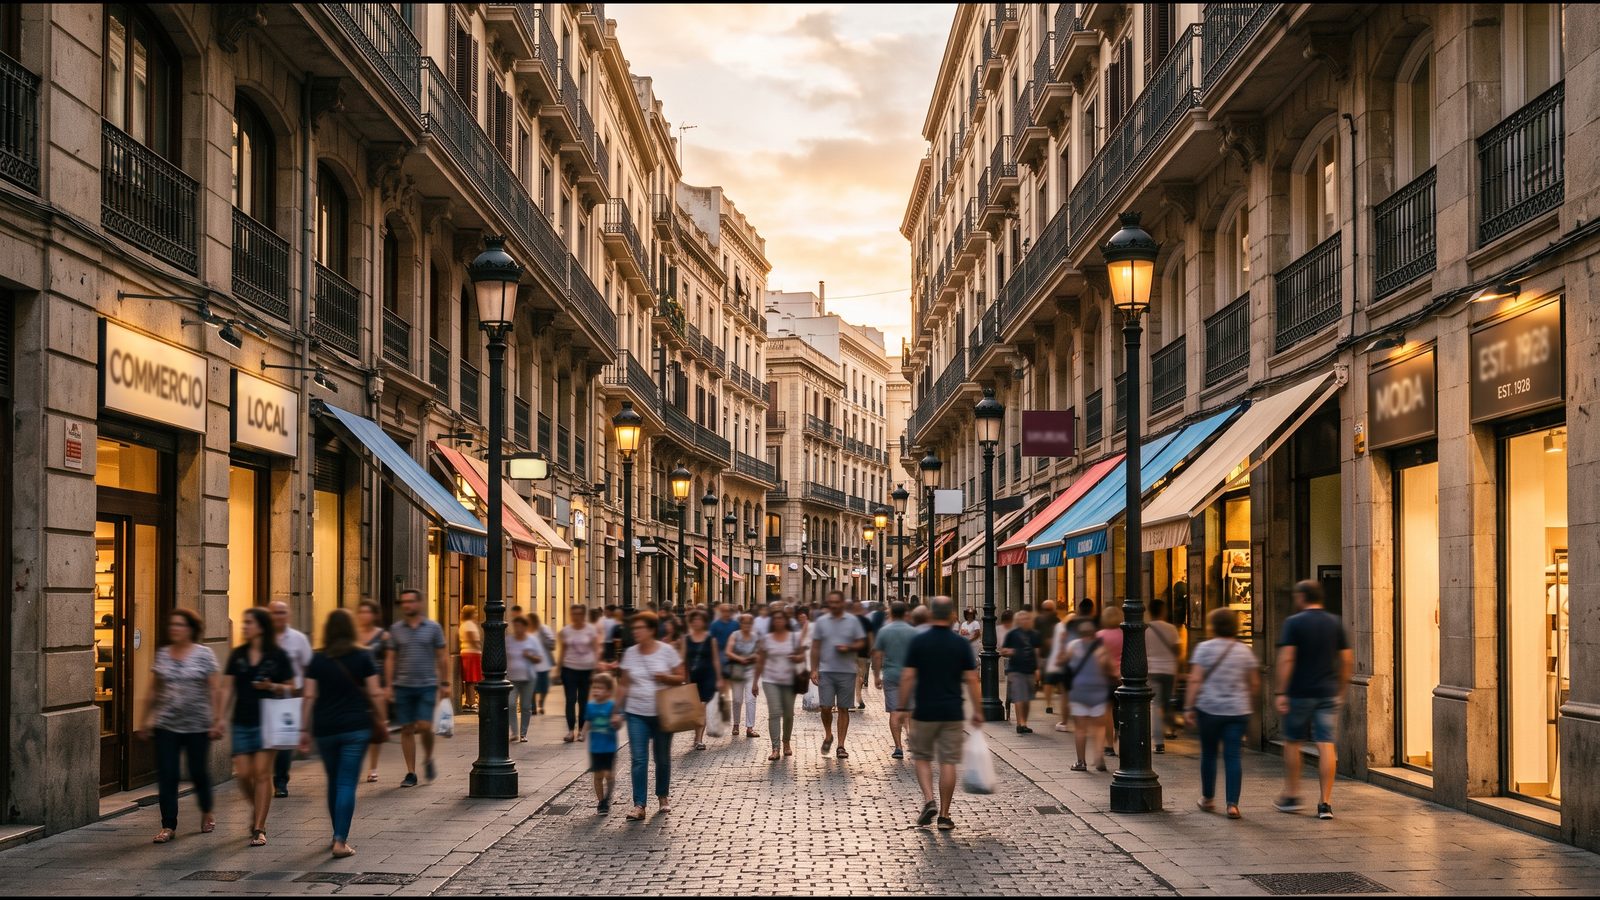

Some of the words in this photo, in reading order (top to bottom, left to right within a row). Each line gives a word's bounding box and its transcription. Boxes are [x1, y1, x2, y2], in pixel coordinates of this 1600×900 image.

[110, 348, 203, 410] COMMERCIO
[1479, 342, 1512, 381] EST.
[1376, 374, 1424, 421] MODA
[1498, 384, 1513, 399] EST.
[1514, 378, 1531, 395] 1928
[247, 396, 288, 437] LOCAL
